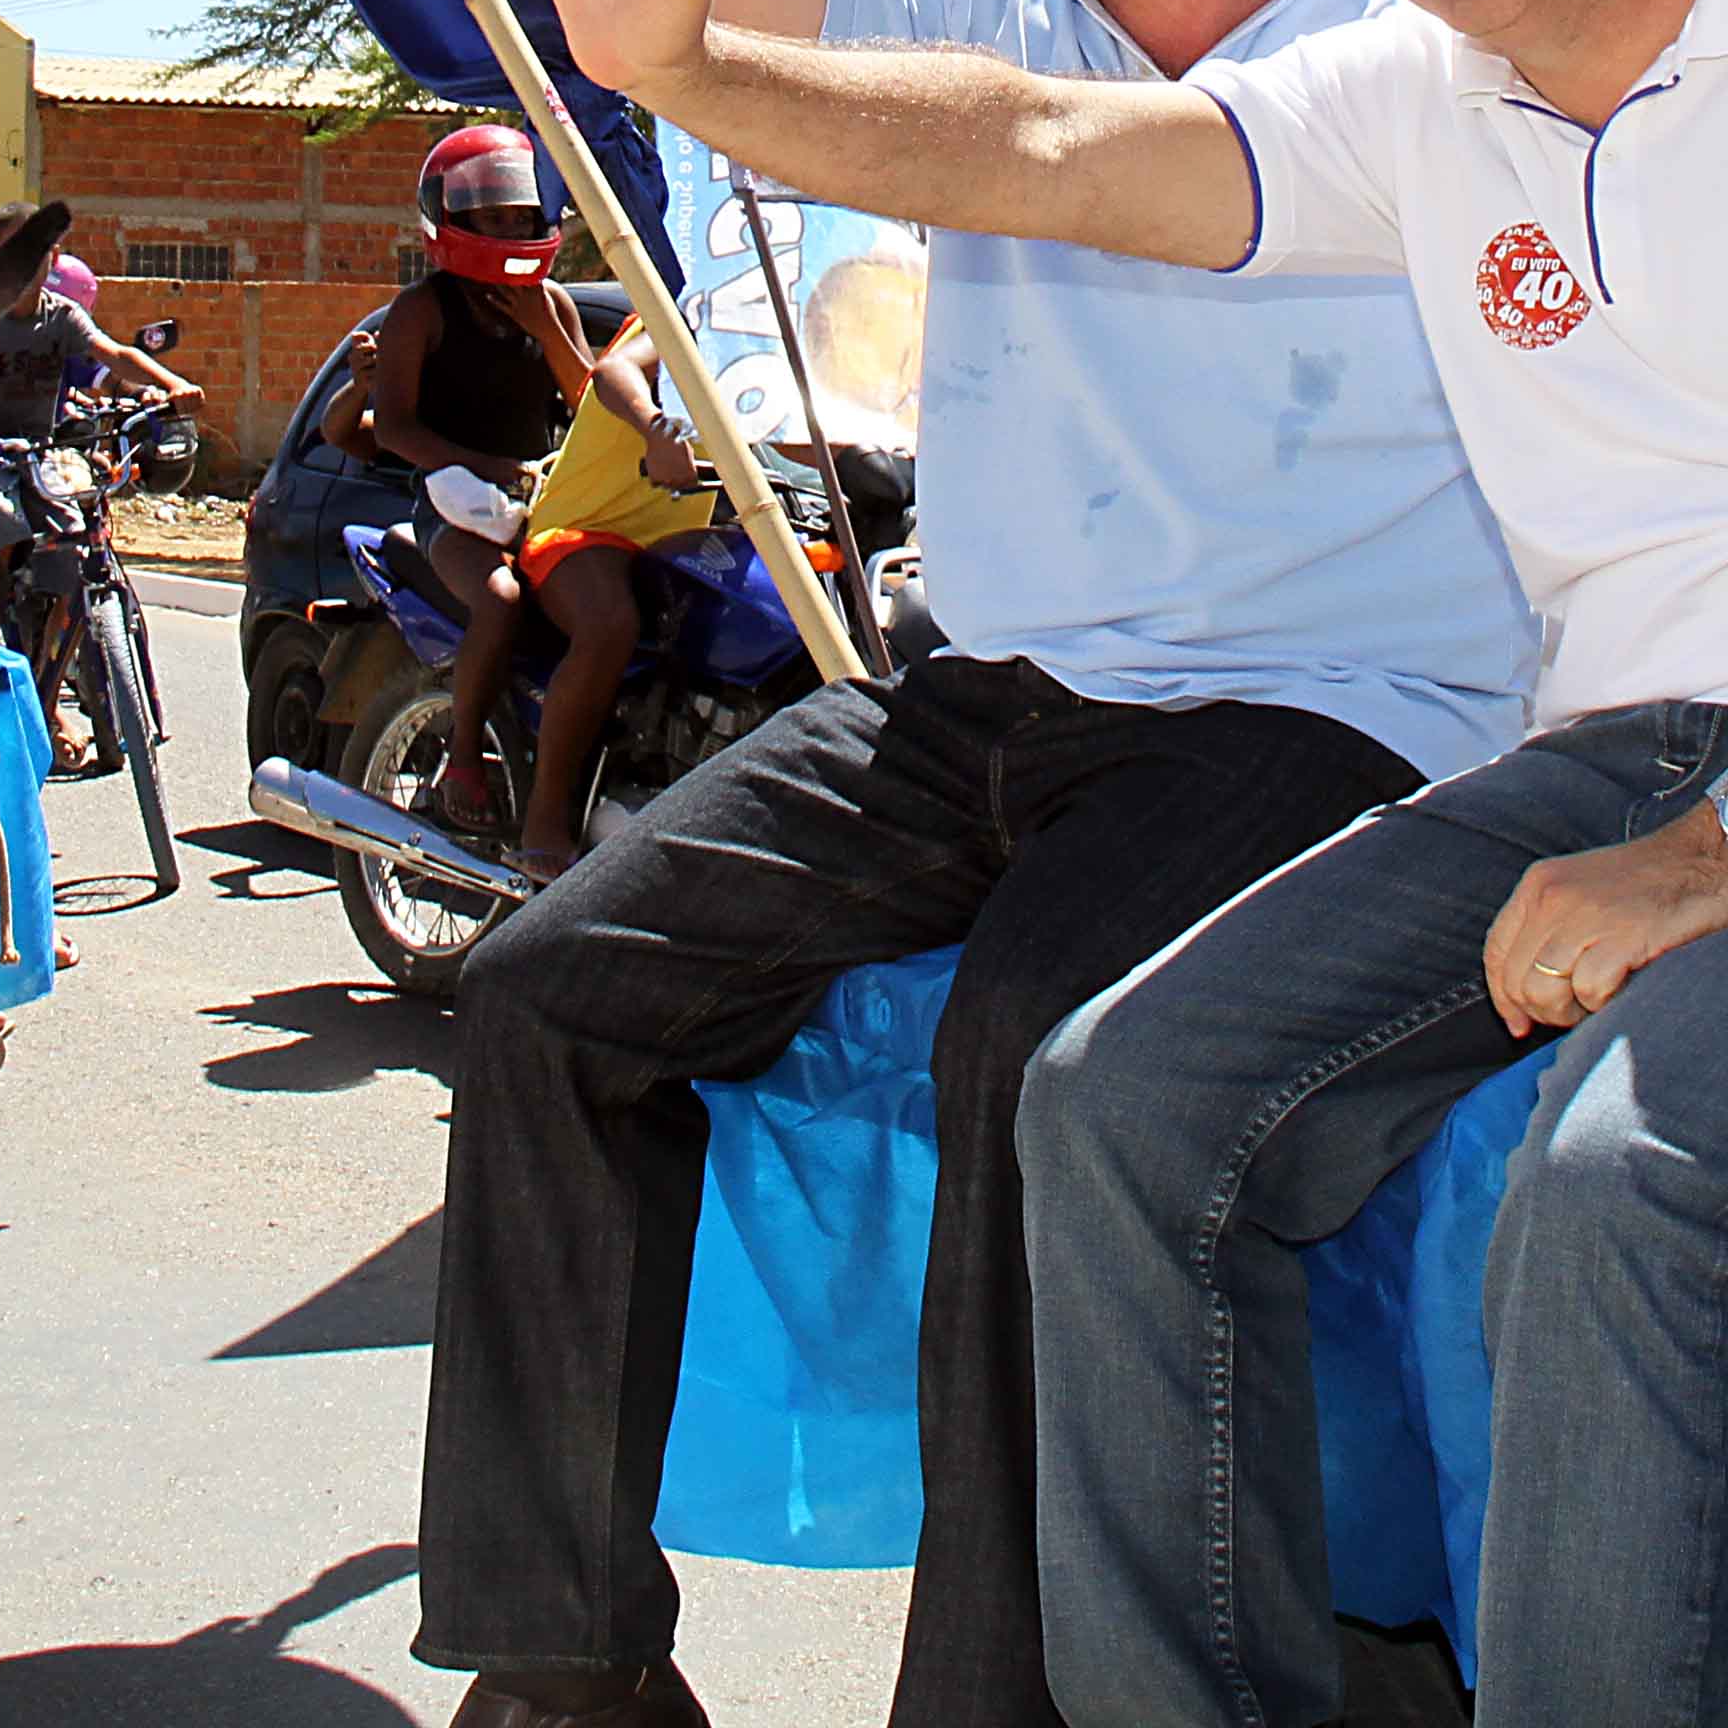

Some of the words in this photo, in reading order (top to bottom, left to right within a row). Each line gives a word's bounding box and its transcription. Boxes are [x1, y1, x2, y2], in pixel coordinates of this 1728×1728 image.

[1511, 257, 1528, 271] EU
[1530, 257, 1561, 271] VOTO
[1512, 271, 1574, 312] 40
[1496, 303, 1525, 327] 40
